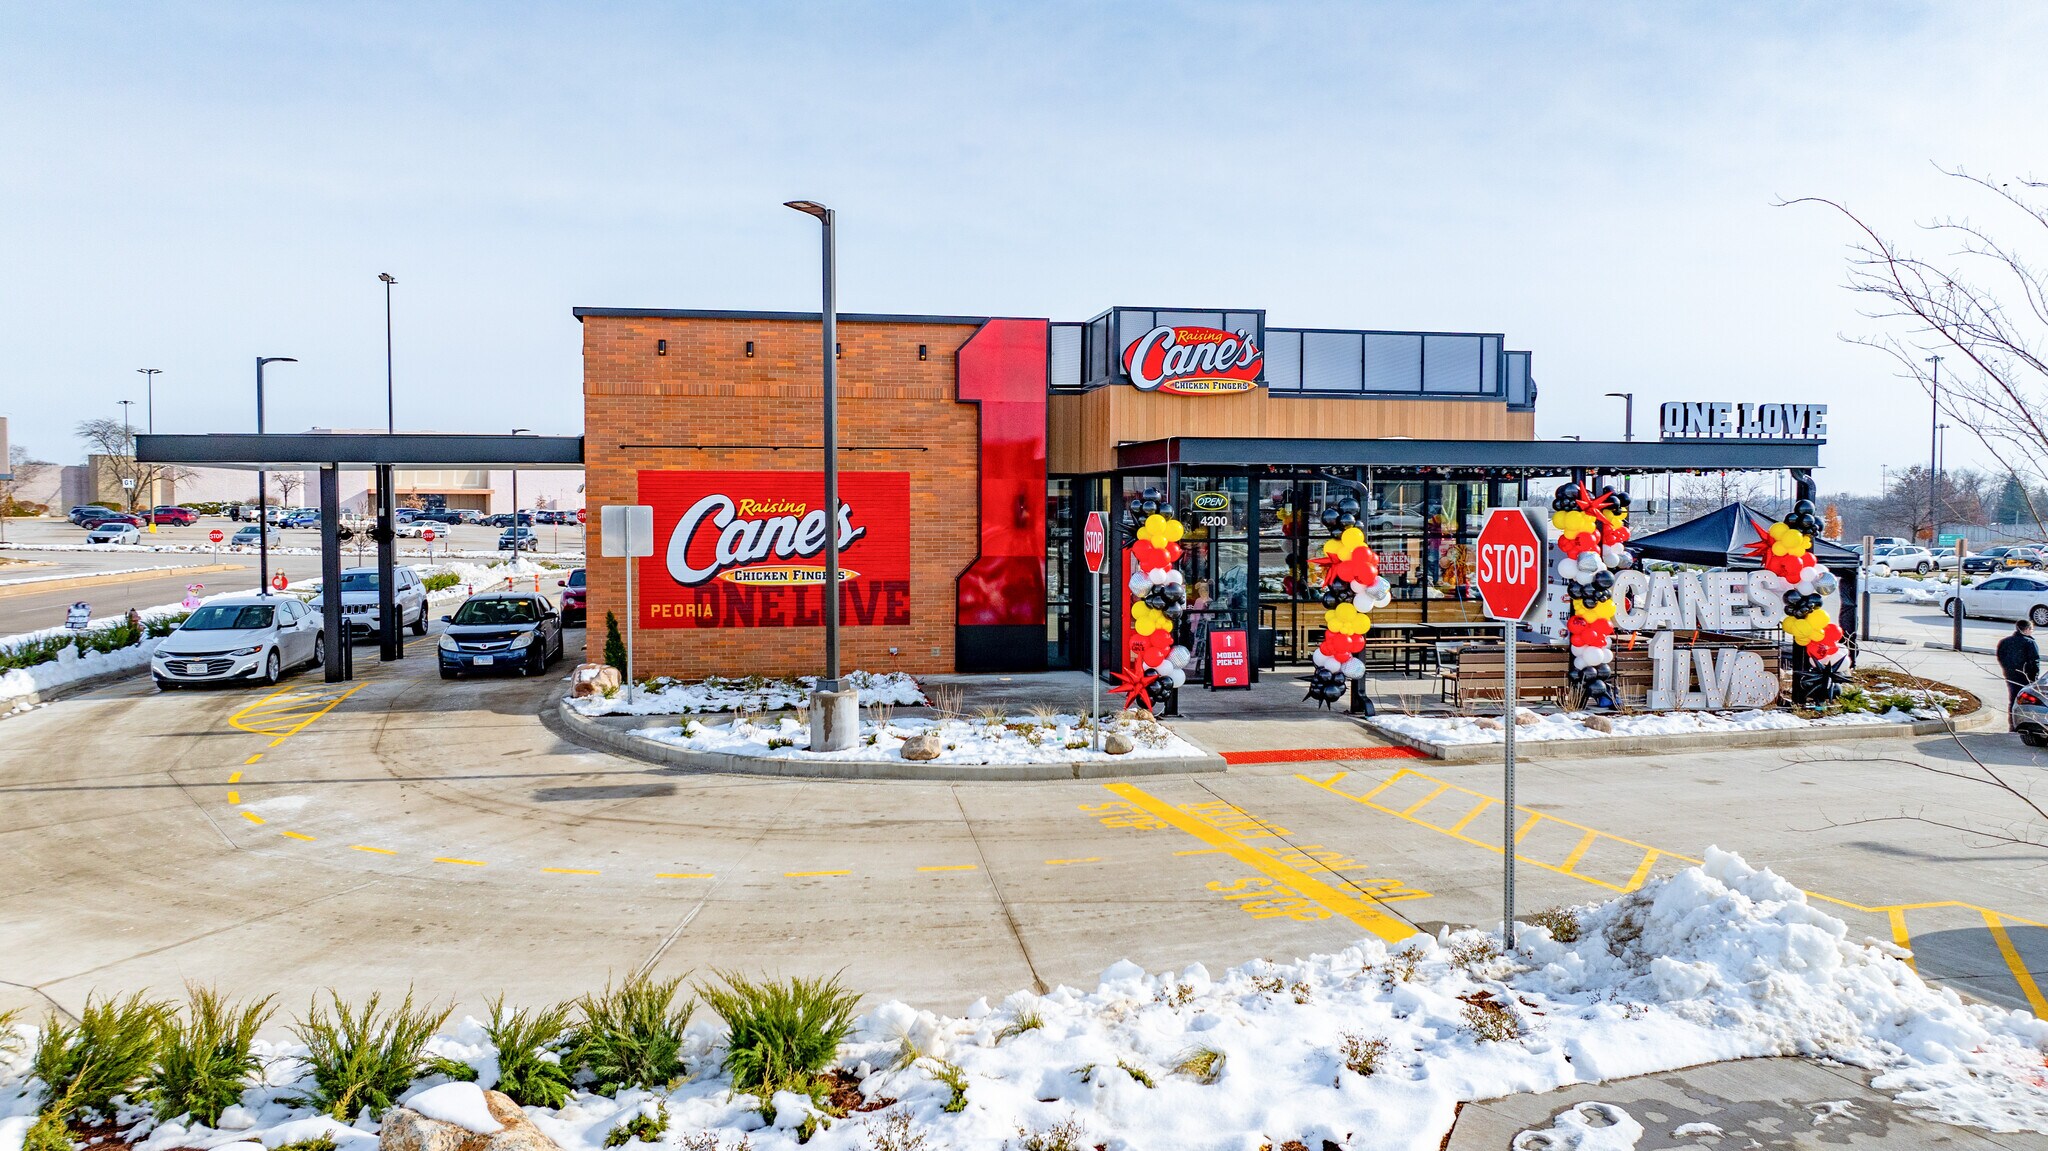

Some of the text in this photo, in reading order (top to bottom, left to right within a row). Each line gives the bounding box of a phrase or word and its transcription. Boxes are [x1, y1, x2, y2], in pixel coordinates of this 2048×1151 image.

[1177, 330, 1223, 345] Raising
[1130, 326, 1263, 390] Cane's
[1174, 381, 1248, 390] CHICKEN FINGERS
[1661, 402, 1828, 435] ONE LOVE
[738, 499, 806, 518] Raising
[1197, 497, 1224, 506] OPEN
[1200, 516, 1228, 527] 4200
[1086, 531, 1102, 553] STOP
[1379, 555, 1410, 563] HICKEN
[1480, 543, 1535, 585] STOP
[734, 570, 845, 581] CHICKEN FINGES
[651, 603, 713, 618] PEORIA
[694, 582, 785, 629] ONE
[1612, 569, 1784, 630] CANES
[1647, 624, 1738, 709] 1LV
[1077, 801, 1168, 831] STOP
[1177, 800, 1434, 904] DO NOT ENTER
[1205, 877, 1333, 921] STOP
